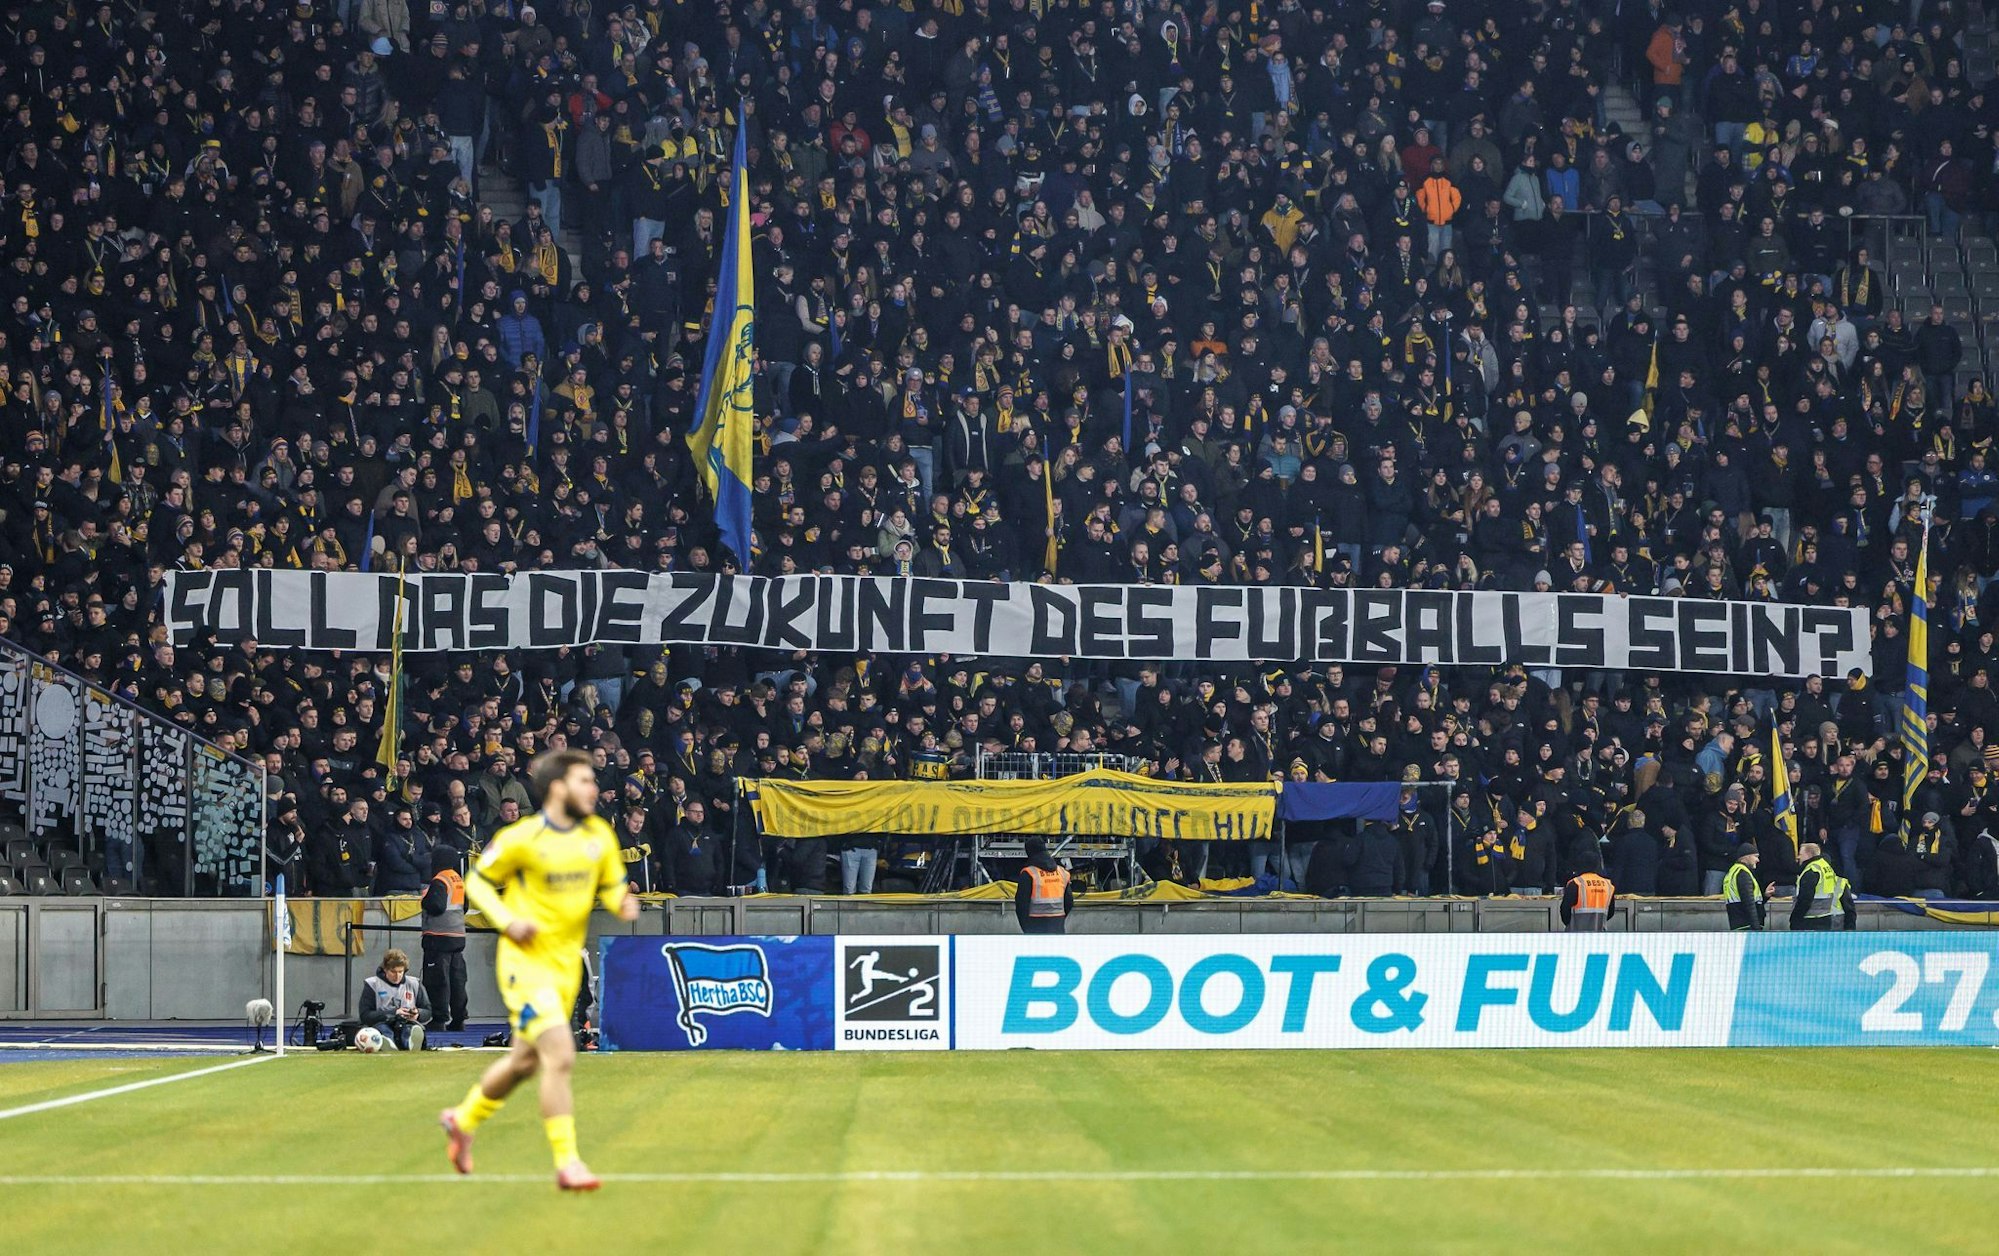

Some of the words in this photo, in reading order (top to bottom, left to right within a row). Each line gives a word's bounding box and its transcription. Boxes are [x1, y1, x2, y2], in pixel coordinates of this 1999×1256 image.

[171, 570, 357, 650] SOLL
[376, 575, 509, 650] DAS
[529, 572, 650, 646] DIE
[660, 572, 1010, 653] ZUKUNFT
[1030, 585, 1174, 658] DES
[1629, 599, 1852, 676] SEIN?
[1586, 879, 1606, 887] BEST
[690, 982, 738, 1007] Hertha
[738, 982, 765, 1003] BSC
[908, 981, 935, 1017] 2
[1000, 953, 1342, 1035] BOOT
[1350, 952, 1428, 1034] &
[1454, 953, 1695, 1033] FUN
[844, 1028, 939, 1041] BUNDESLIGA
